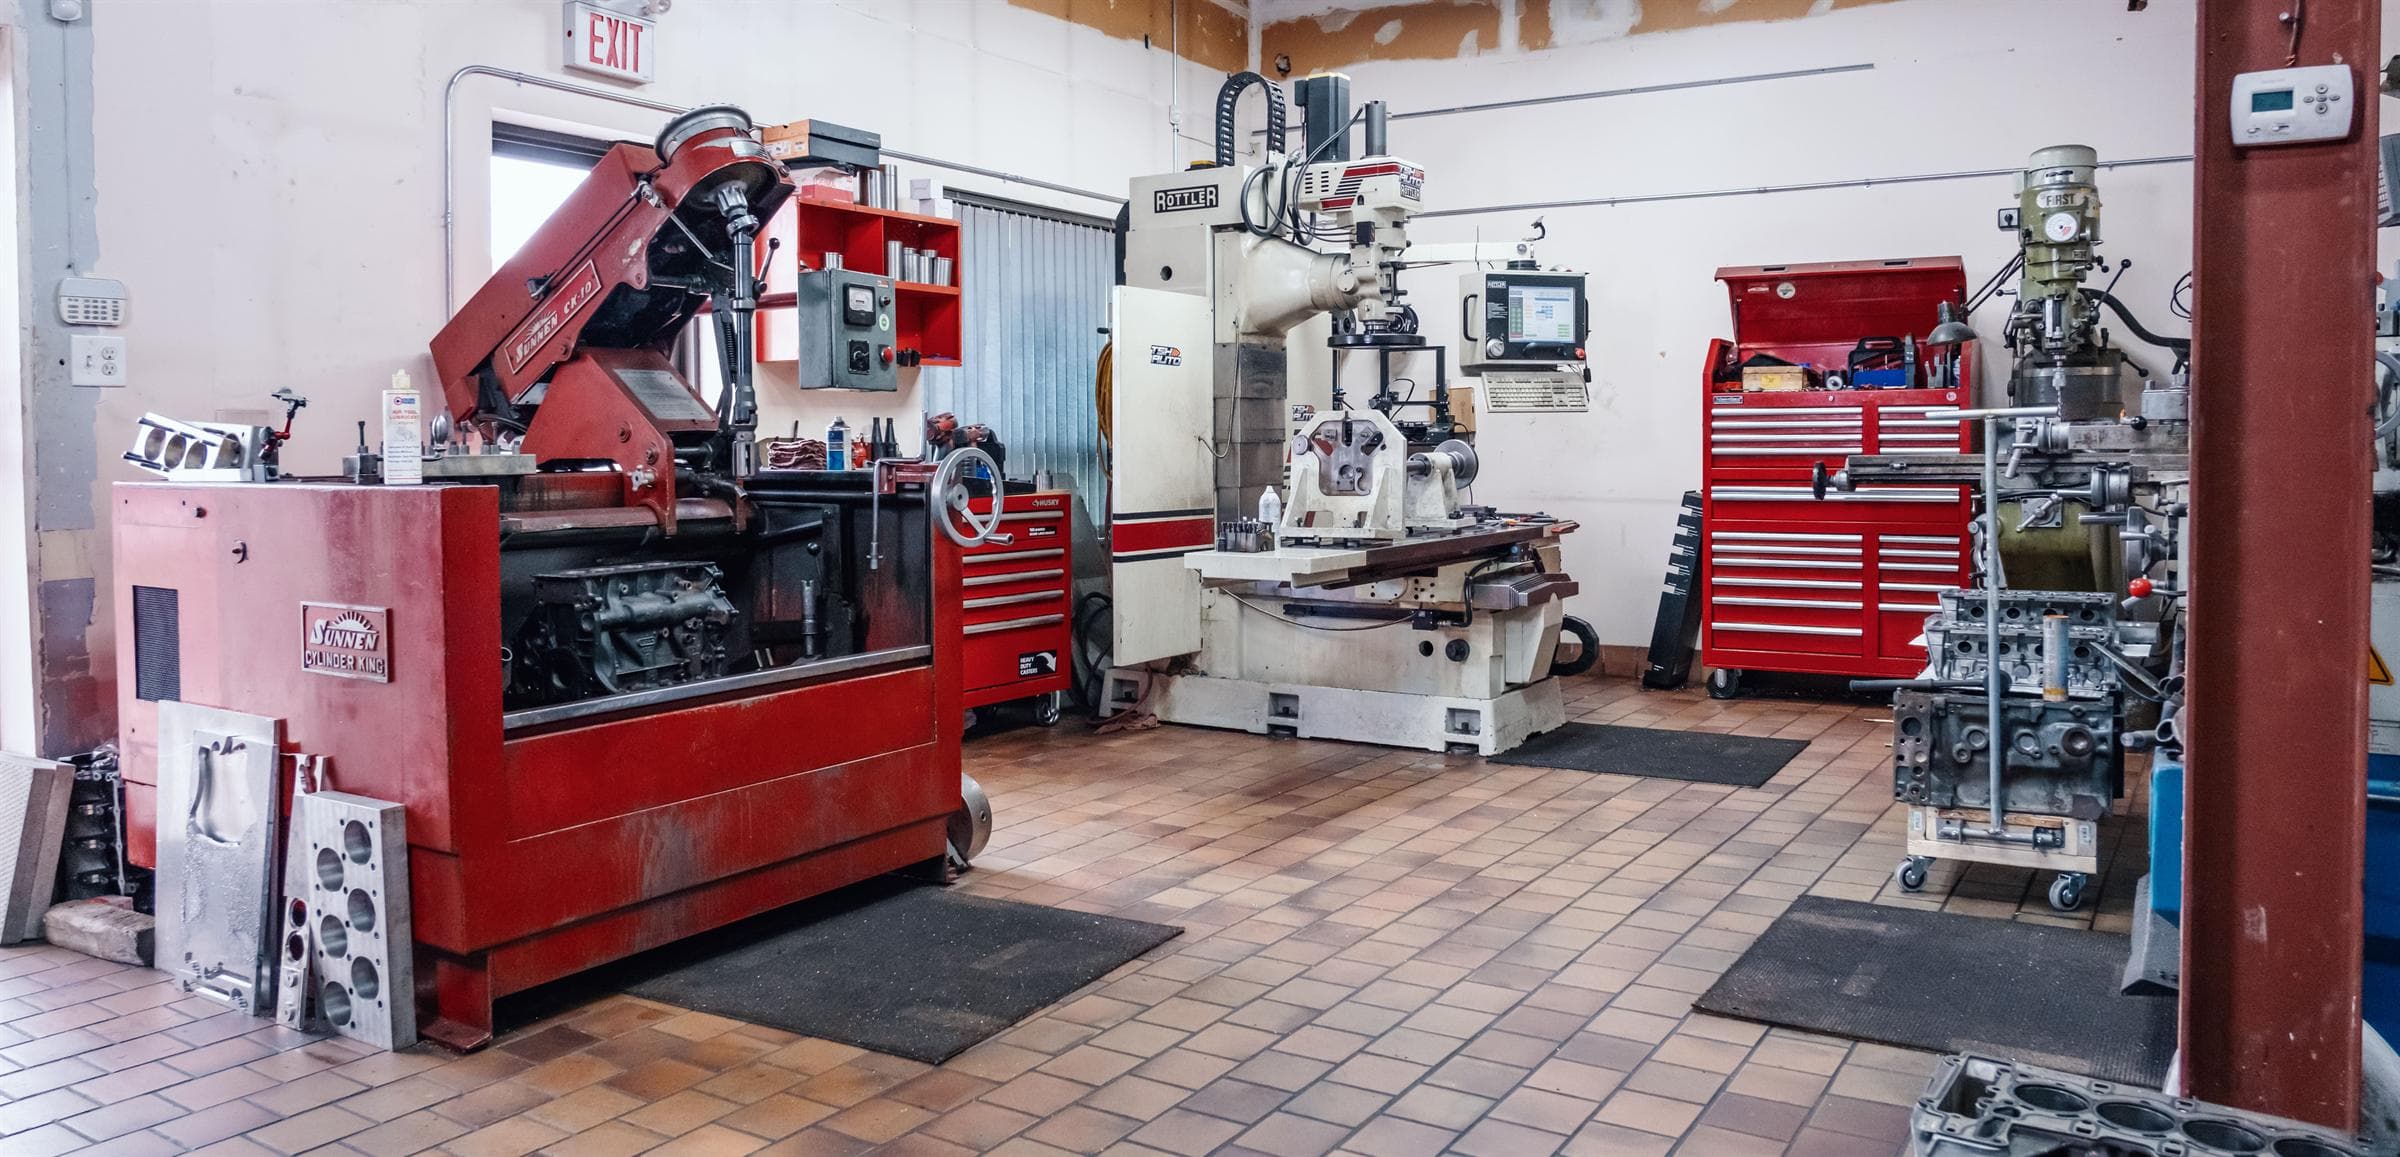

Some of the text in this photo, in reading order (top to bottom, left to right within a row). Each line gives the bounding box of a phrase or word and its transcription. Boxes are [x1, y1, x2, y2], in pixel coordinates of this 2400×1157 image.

[589, 12, 643, 73] EXIT
[1155, 186, 1216, 212] ROTTLER
[2046, 193, 2075, 206] FIRST
[516, 281, 592, 363] SUNNEN CK-10
[1151, 355, 1181, 366] AUTO
[310, 619, 379, 651] SUNNEN
[305, 650, 385, 674] CYLINDER KING
